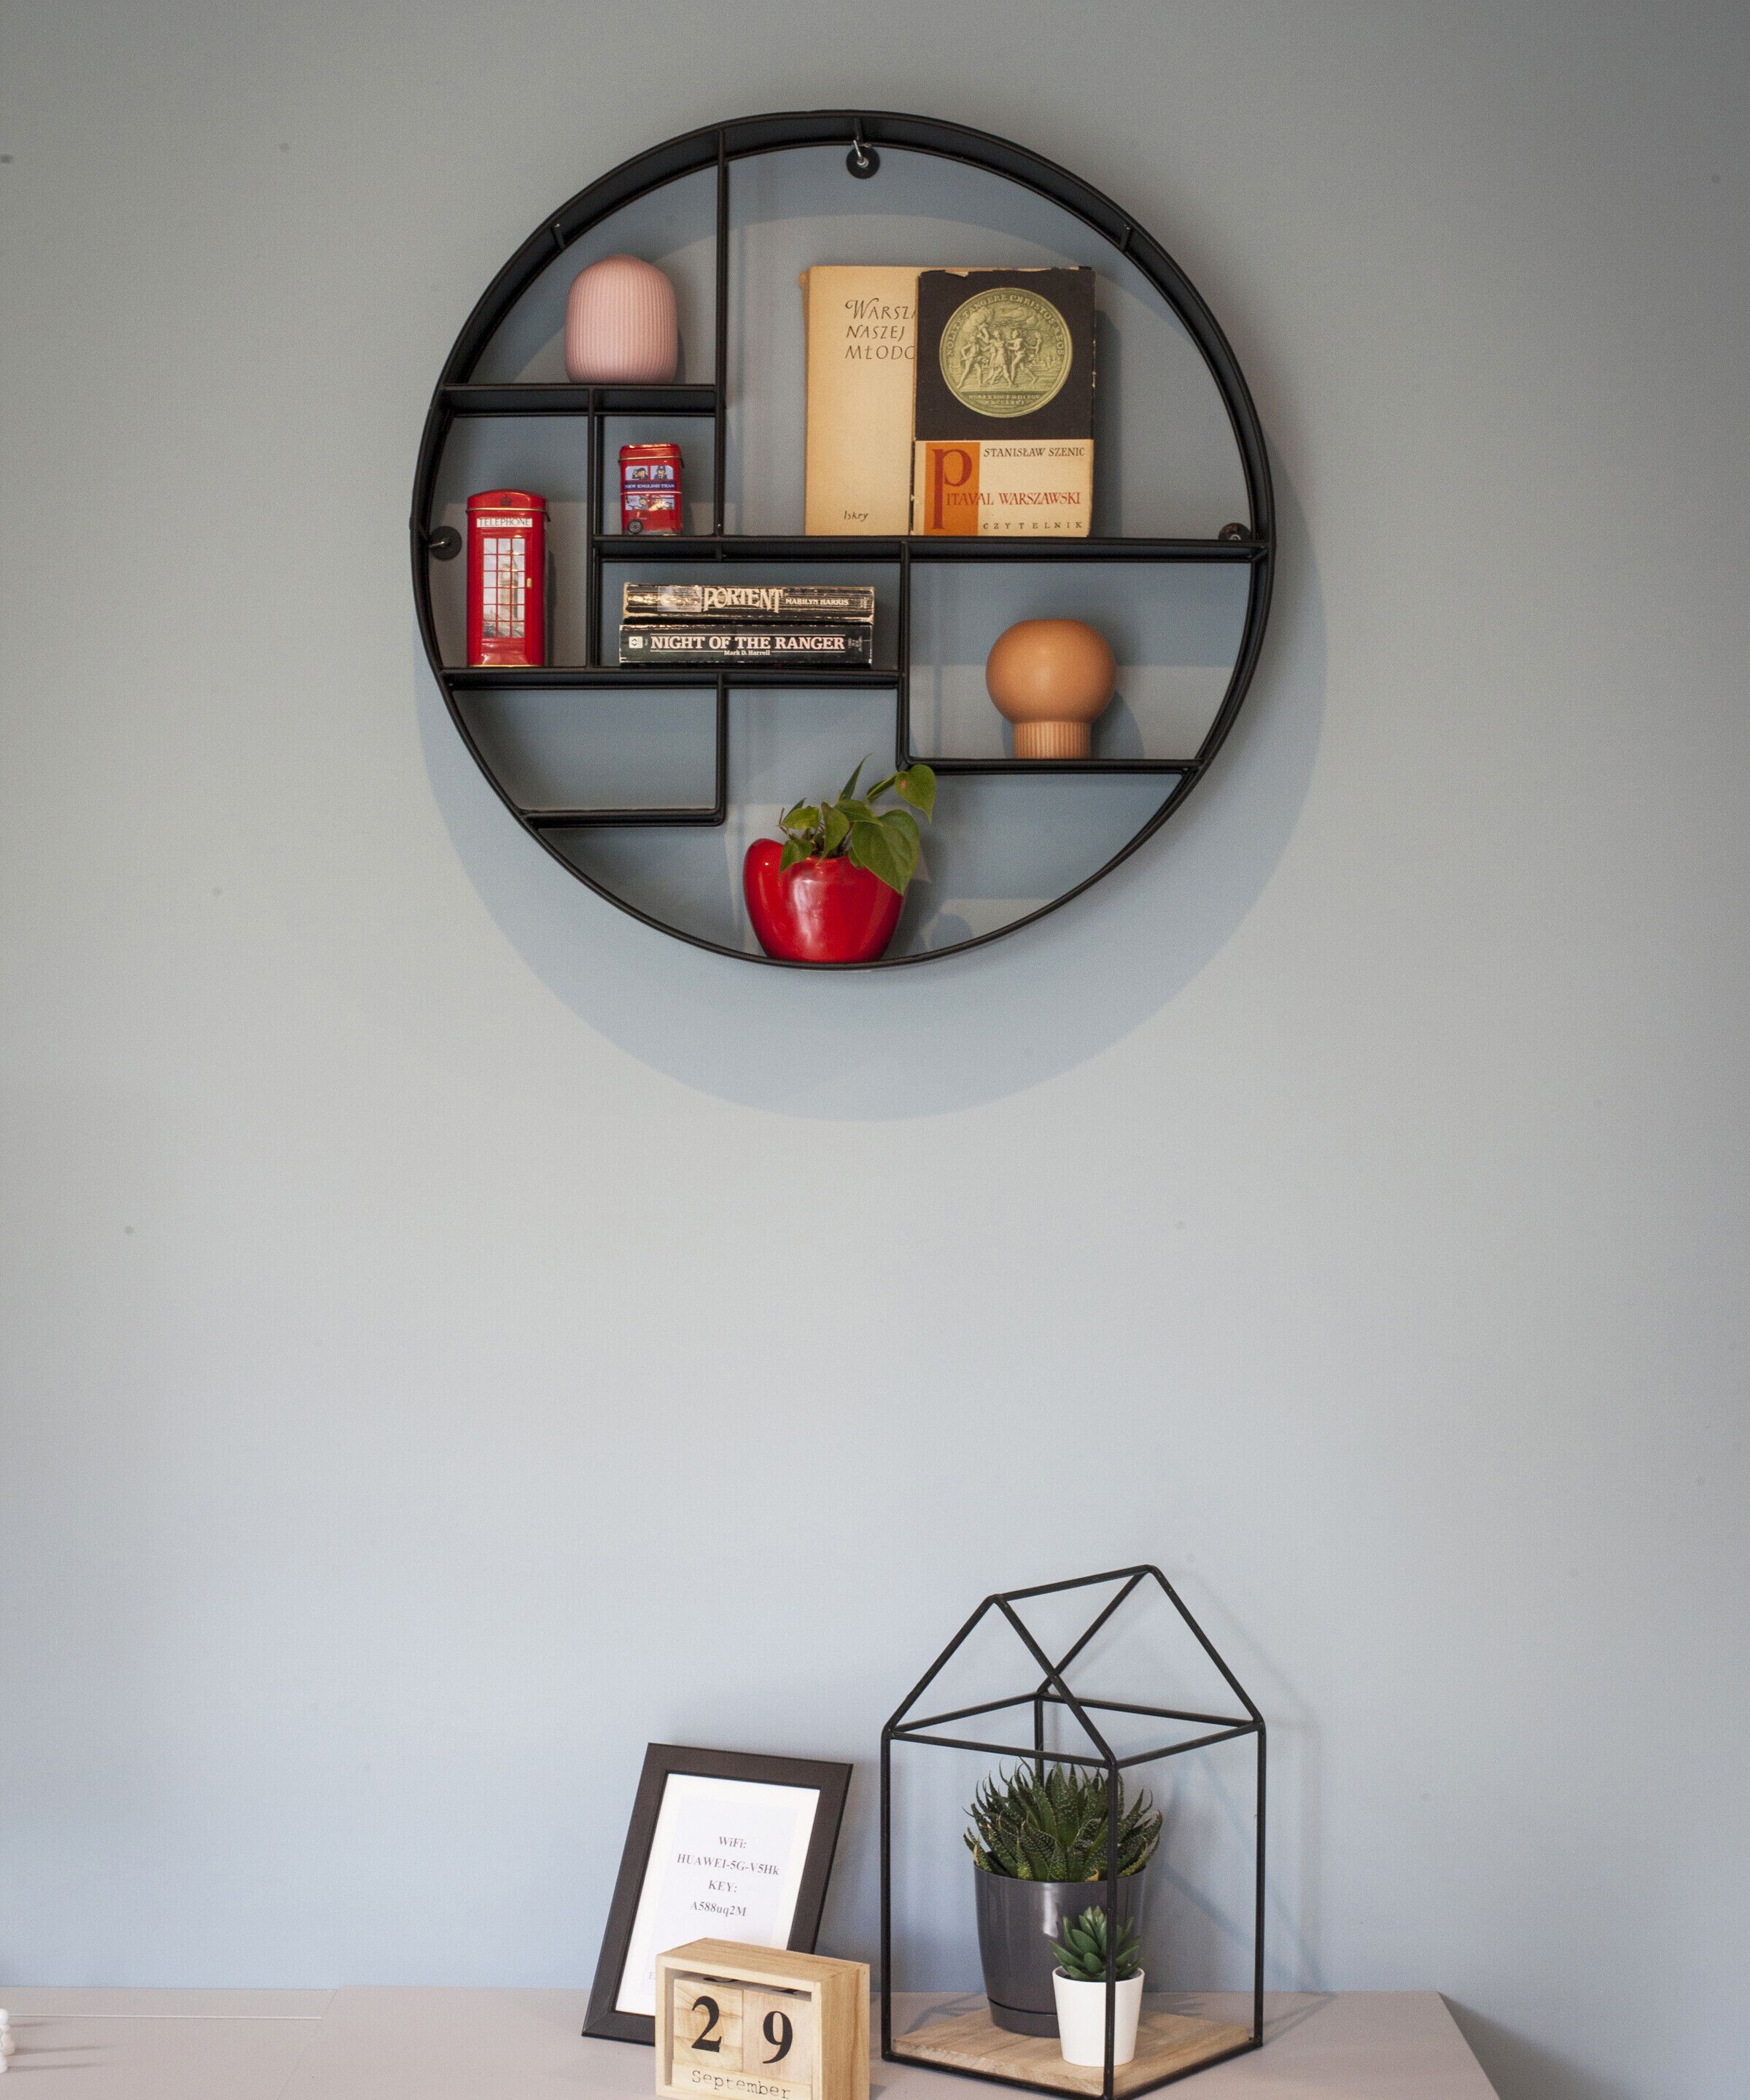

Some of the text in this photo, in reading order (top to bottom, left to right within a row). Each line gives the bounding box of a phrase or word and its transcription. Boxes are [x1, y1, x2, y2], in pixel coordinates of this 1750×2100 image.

[846, 324, 905, 342] NASZEJ
[983, 447, 1086, 458] STANISŁAW SZENIC
[999, 491, 1081, 505] WARSZAWSKI
[478, 517, 532, 526] TELEPHONE
[843, 510, 869, 522] Iskry
[983, 521, 1083, 530] CZYTELNIK
[703, 587, 783, 614] PORTENT
[650, 636, 706, 649] NIGHT
[709, 636, 731, 649] OF
[734, 637, 771, 650] THE
[774, 637, 846, 650] RANGER
[719, 1836, 747, 1849] WiFi:
[708, 1880, 738, 1893] KEY:
[692, 2070, 792, 2099] September
